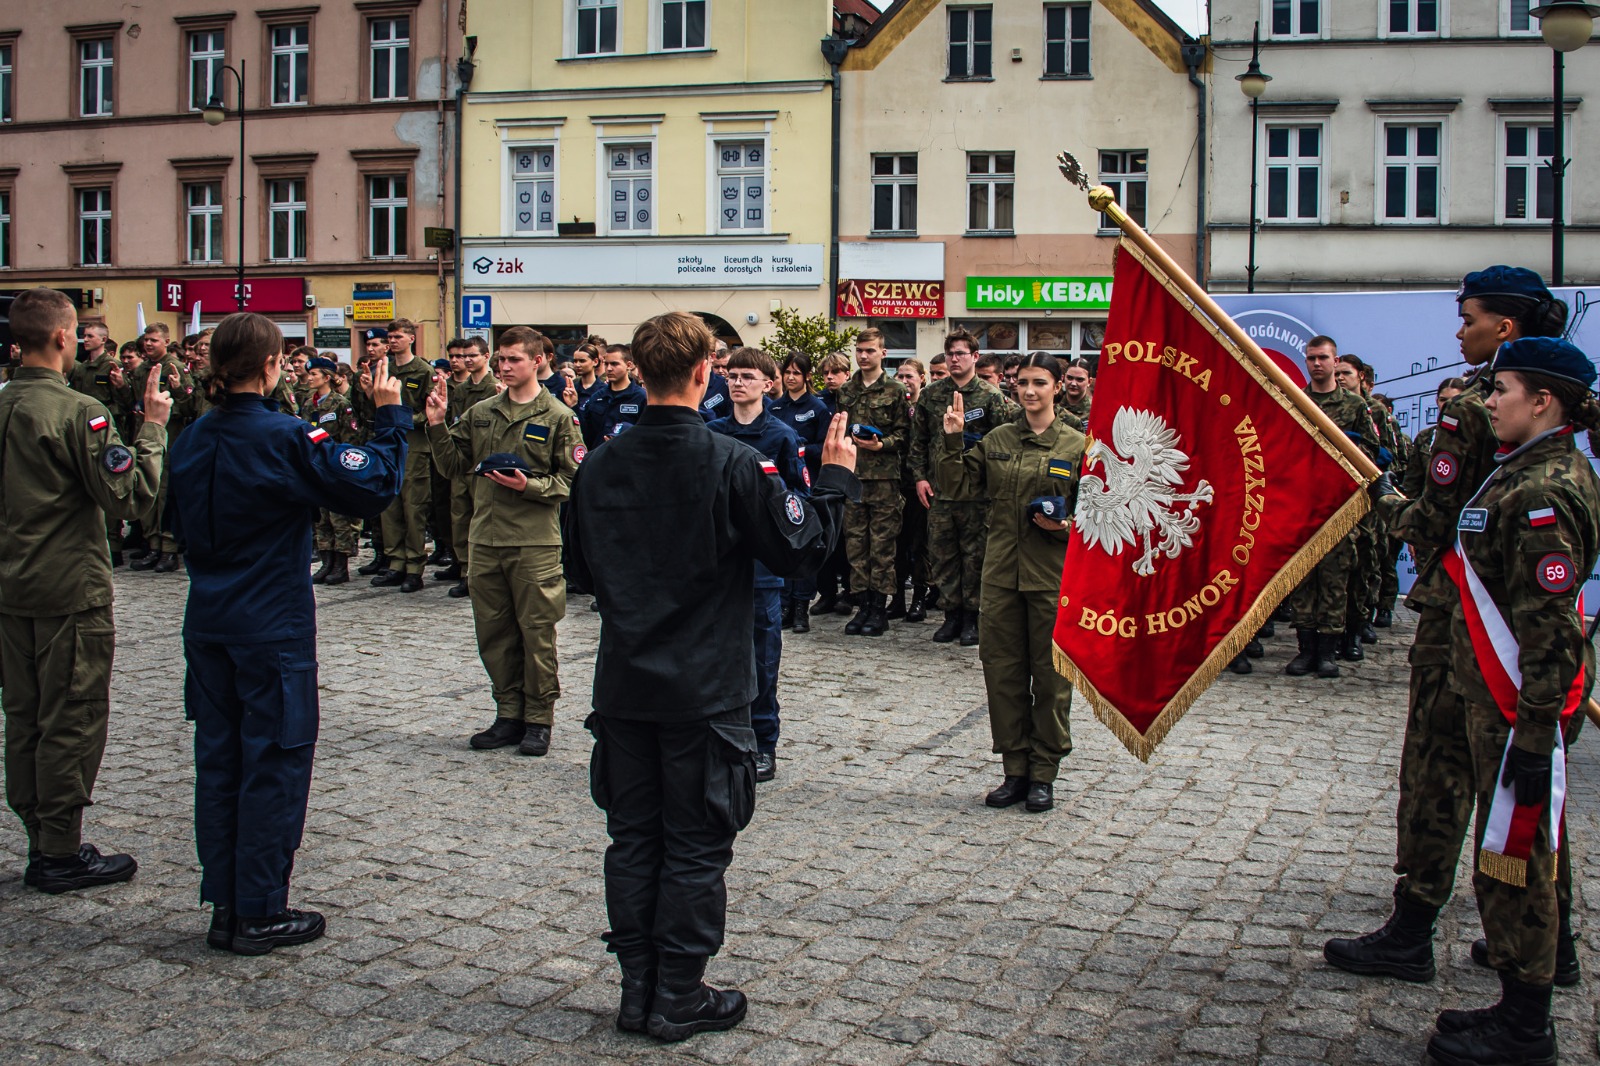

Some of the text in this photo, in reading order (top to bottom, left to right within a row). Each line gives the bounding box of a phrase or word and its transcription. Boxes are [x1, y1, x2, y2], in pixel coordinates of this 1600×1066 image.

[496, 257, 524, 273] żak
[677, 255, 703, 265] szkoły
[724, 255, 763, 264] liceum dla
[771, 255, 793, 265] kursy
[677, 265, 716, 274] policealne
[723, 265, 762, 274] dorosłych
[776, 265, 813, 273] szkolenia
[864, 282, 940, 300] SZEWC
[976, 284, 1025, 306] Holy
[469, 299, 486, 324] P
[871, 306, 938, 316] 601 570 972
[1104, 340, 1212, 392] POLSKA
[1436, 460, 1450, 476] 59
[1232, 414, 1266, 566] OJCZYZNA
[1546, 564, 1565, 581] 59
[1078, 569, 1240, 638] BÓG HONOR
